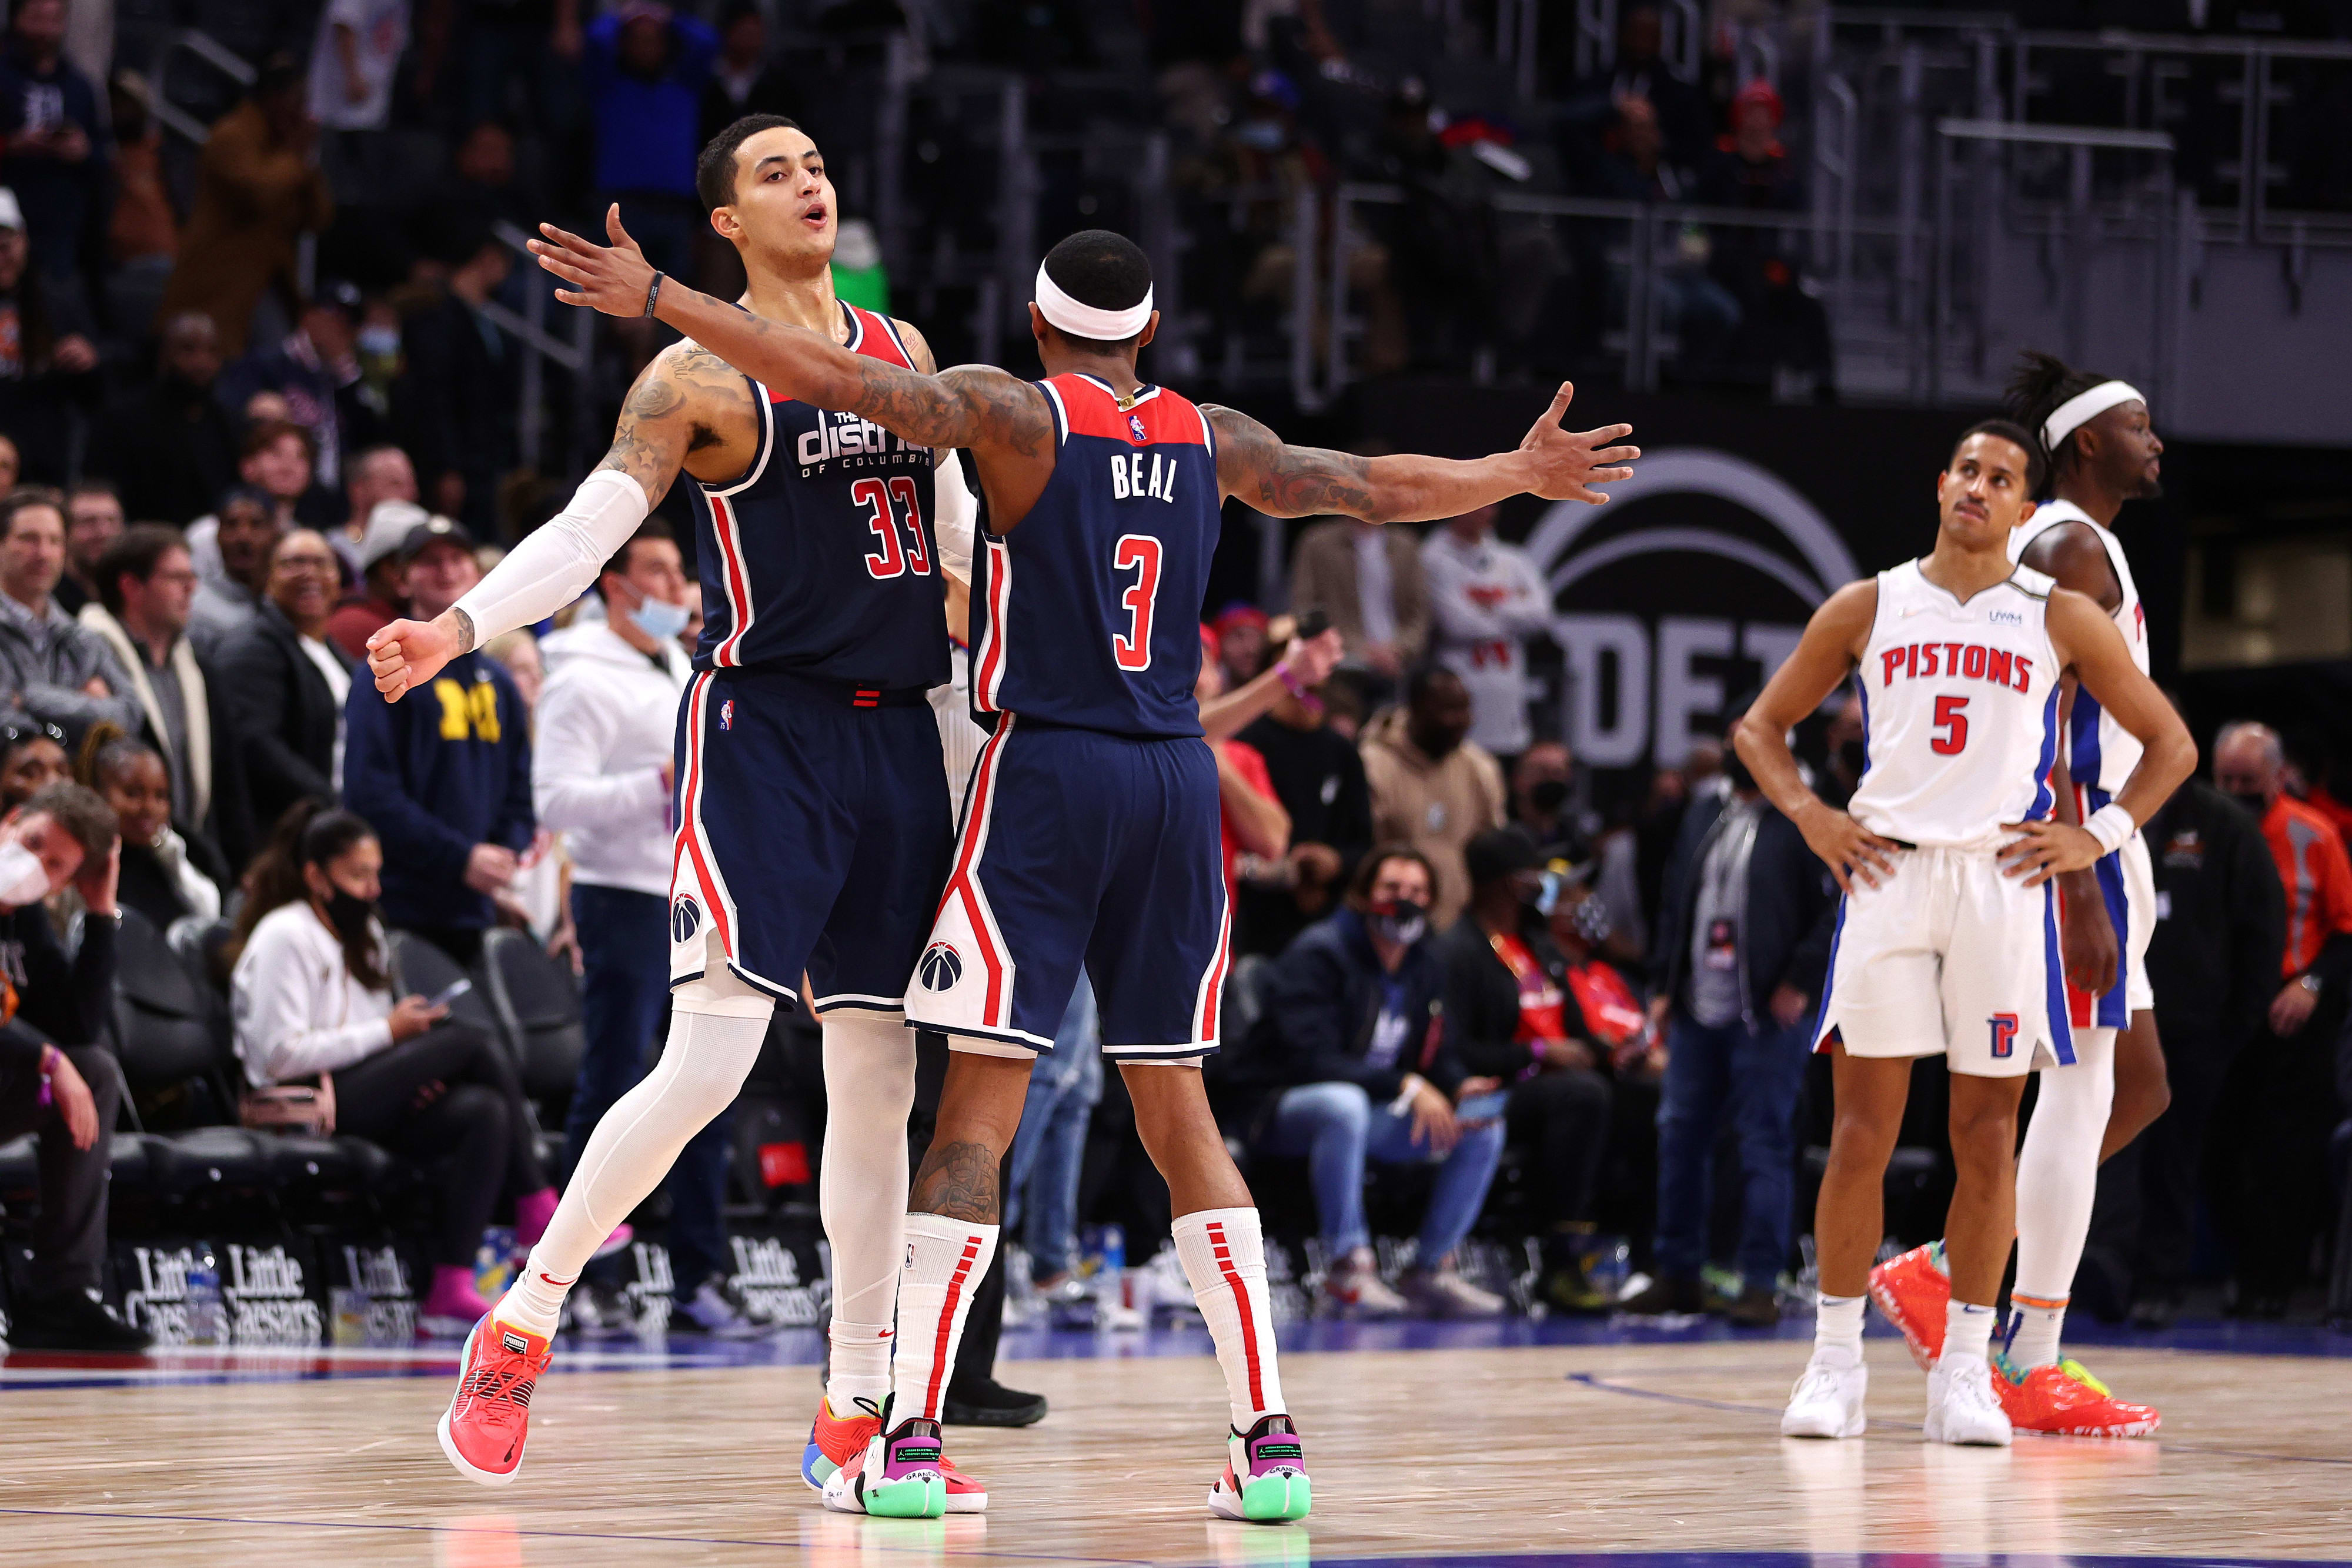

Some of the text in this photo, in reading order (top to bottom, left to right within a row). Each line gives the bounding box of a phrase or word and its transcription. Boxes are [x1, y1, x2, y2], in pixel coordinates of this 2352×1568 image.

[834, 412, 859, 423] THE
[802, 464, 826, 478] OF
[843, 454, 930, 469] COLUMBIA
[1111, 453, 1177, 504] BEAL
[851, 476, 931, 579] 33
[1112, 533, 1163, 671] 3
[1989, 610, 2022, 624] UWM
[1880, 643, 2033, 694] PISTONS
[1931, 696, 1970, 755] 5
[226, 1243, 305, 1298] Little
[505, 1335, 525, 1348] PUMA
